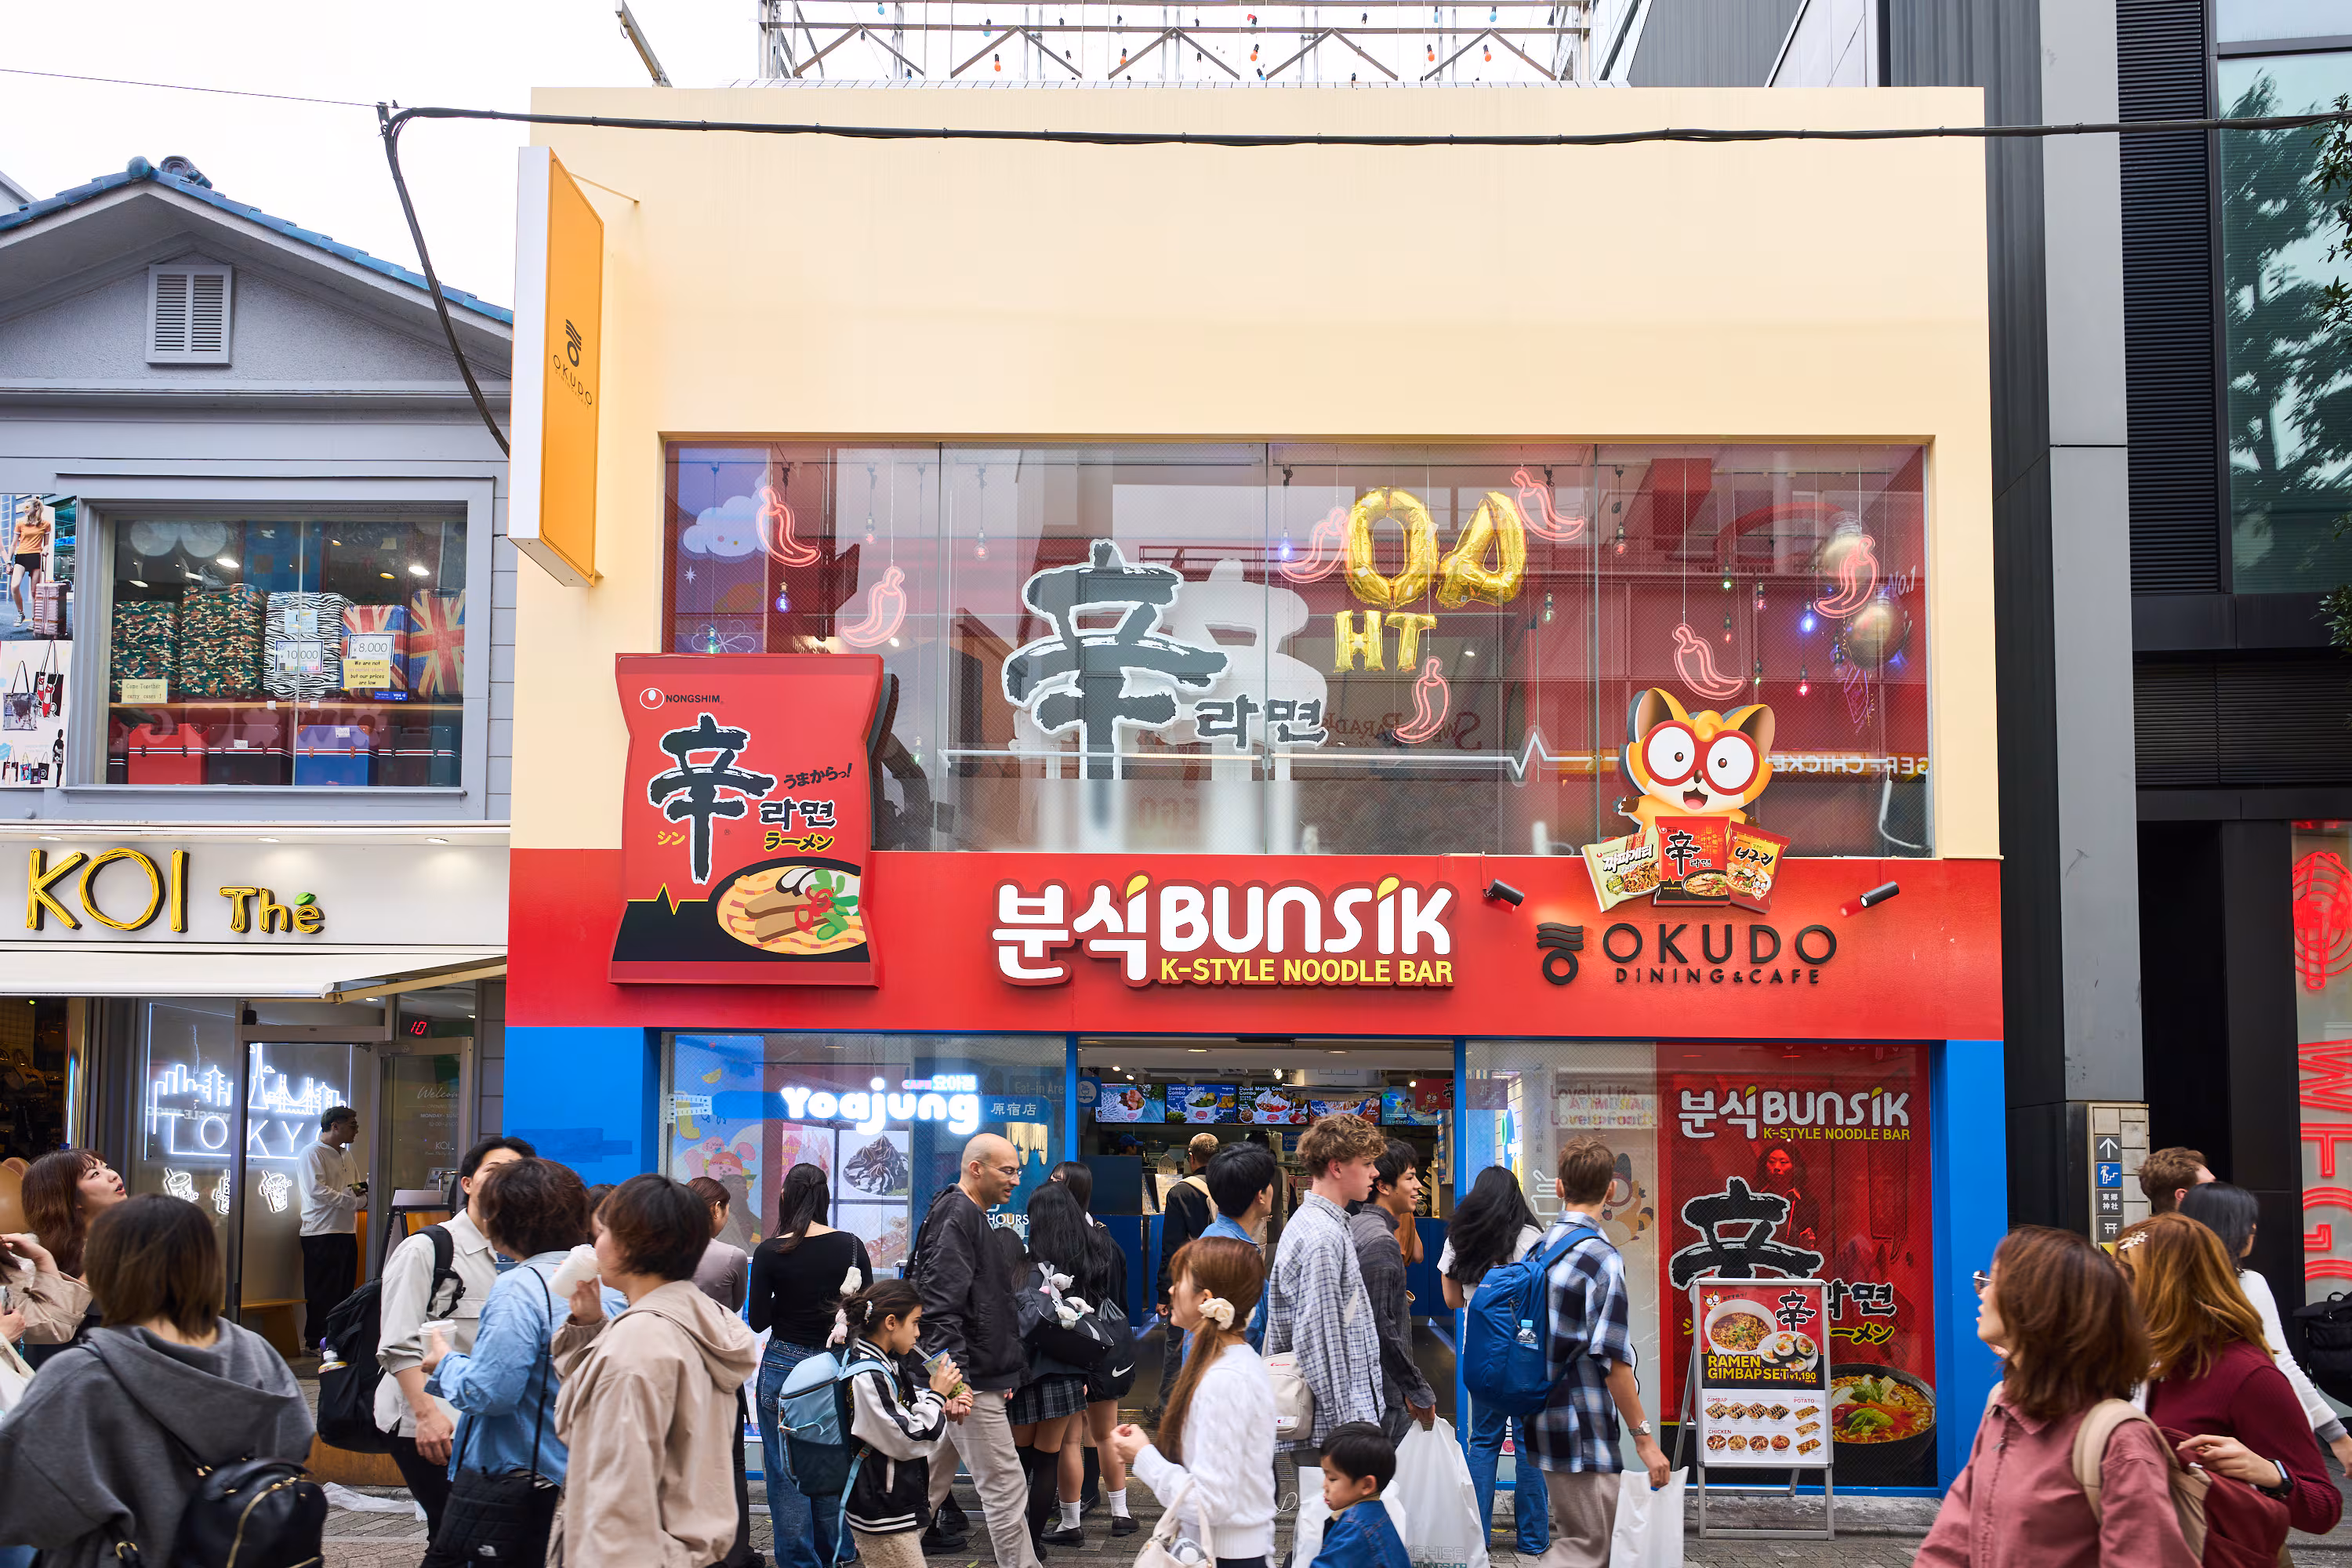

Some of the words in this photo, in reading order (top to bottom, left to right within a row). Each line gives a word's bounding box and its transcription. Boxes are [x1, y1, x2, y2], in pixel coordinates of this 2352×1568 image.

[554, 354, 592, 405] OKUDO
[286, 650, 318, 659] 10000
[358, 643, 388, 653] 8,000
[1001, 538, 1232, 823] 辛
[666, 695, 720, 703] NONGSHIM
[1193, 694, 1329, 752] 라면
[648, 713, 778, 885] 辛
[759, 797, 837, 831] 라면
[657, 831, 686, 845] シン
[764, 831, 835, 852] ラーメン
[1664, 829, 1701, 877] 辛
[1690, 858, 1712, 868] 라면
[1734, 847, 1774, 866] 너구리
[27, 848, 188, 933] KOI
[992, 874, 1150, 982] 분식
[1602, 922, 1837, 964] OKUDO
[1161, 958, 1275, 982] K-STYLE
[1283, 958, 1391, 982] NOODLE
[1399, 960, 1454, 983] BAR
[410, 1021, 427, 1035] 10
[417, 1085, 459, 1099] Welcom
[1015, 1081, 1046, 1094] Eat-in
[991, 1102, 1036, 1116] 原宿店
[1679, 1086, 1757, 1139] 분식
[162, 1113, 323, 1156] TOKY
[1763, 1127, 1821, 1140] K-STYLE
[1825, 1127, 1879, 1141] NOODLE
[1883, 1128, 1910, 1141] BAR
[987, 1214, 1029, 1225] HOURS
[1775, 1290, 1817, 1331] 辛
[1829, 1322, 1895, 1346] ーメン
[1708, 1356, 1761, 1367] RAMEN
[1708, 1368, 1762, 1380] GIMBAP
[1763, 1368, 1789, 1380] SET
[1789, 1372, 1817, 1381] ¥1,190
